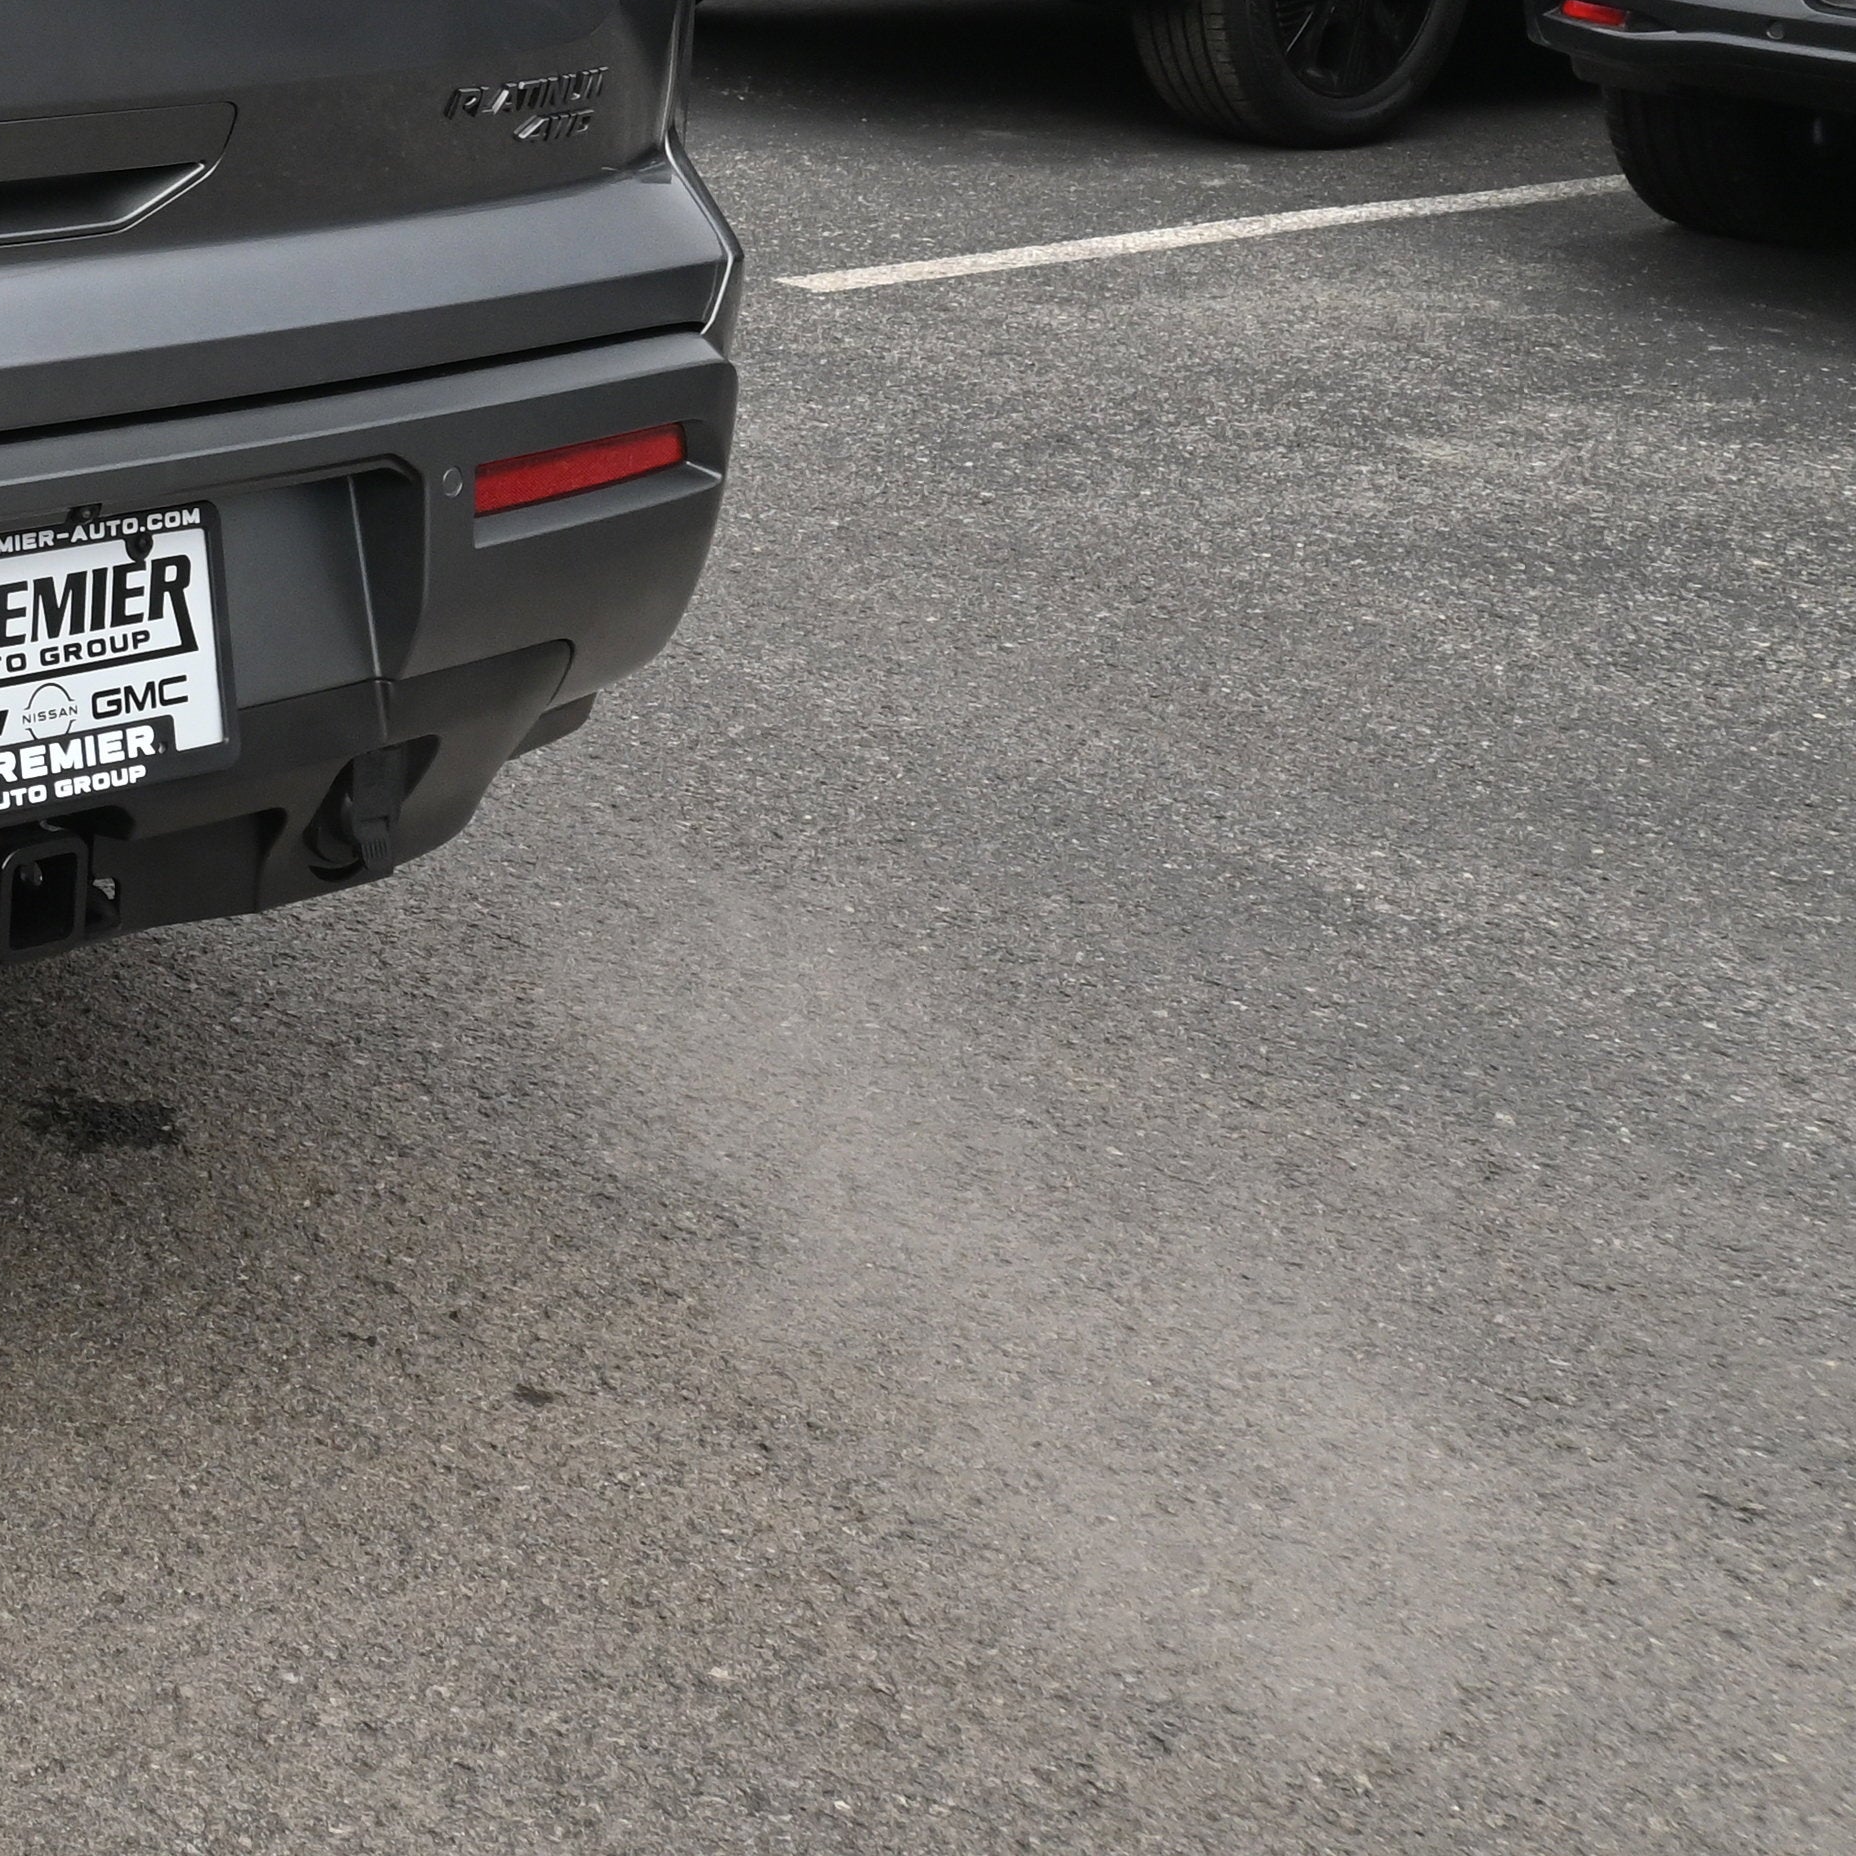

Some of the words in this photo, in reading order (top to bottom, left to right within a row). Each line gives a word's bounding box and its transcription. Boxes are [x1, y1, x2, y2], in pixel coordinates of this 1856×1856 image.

[39, 629, 151, 666] GROUP
[22, 703, 79, 725] NISSAN
[91, 674, 189, 720] GMC
[54, 764, 146, 798] GROUP
